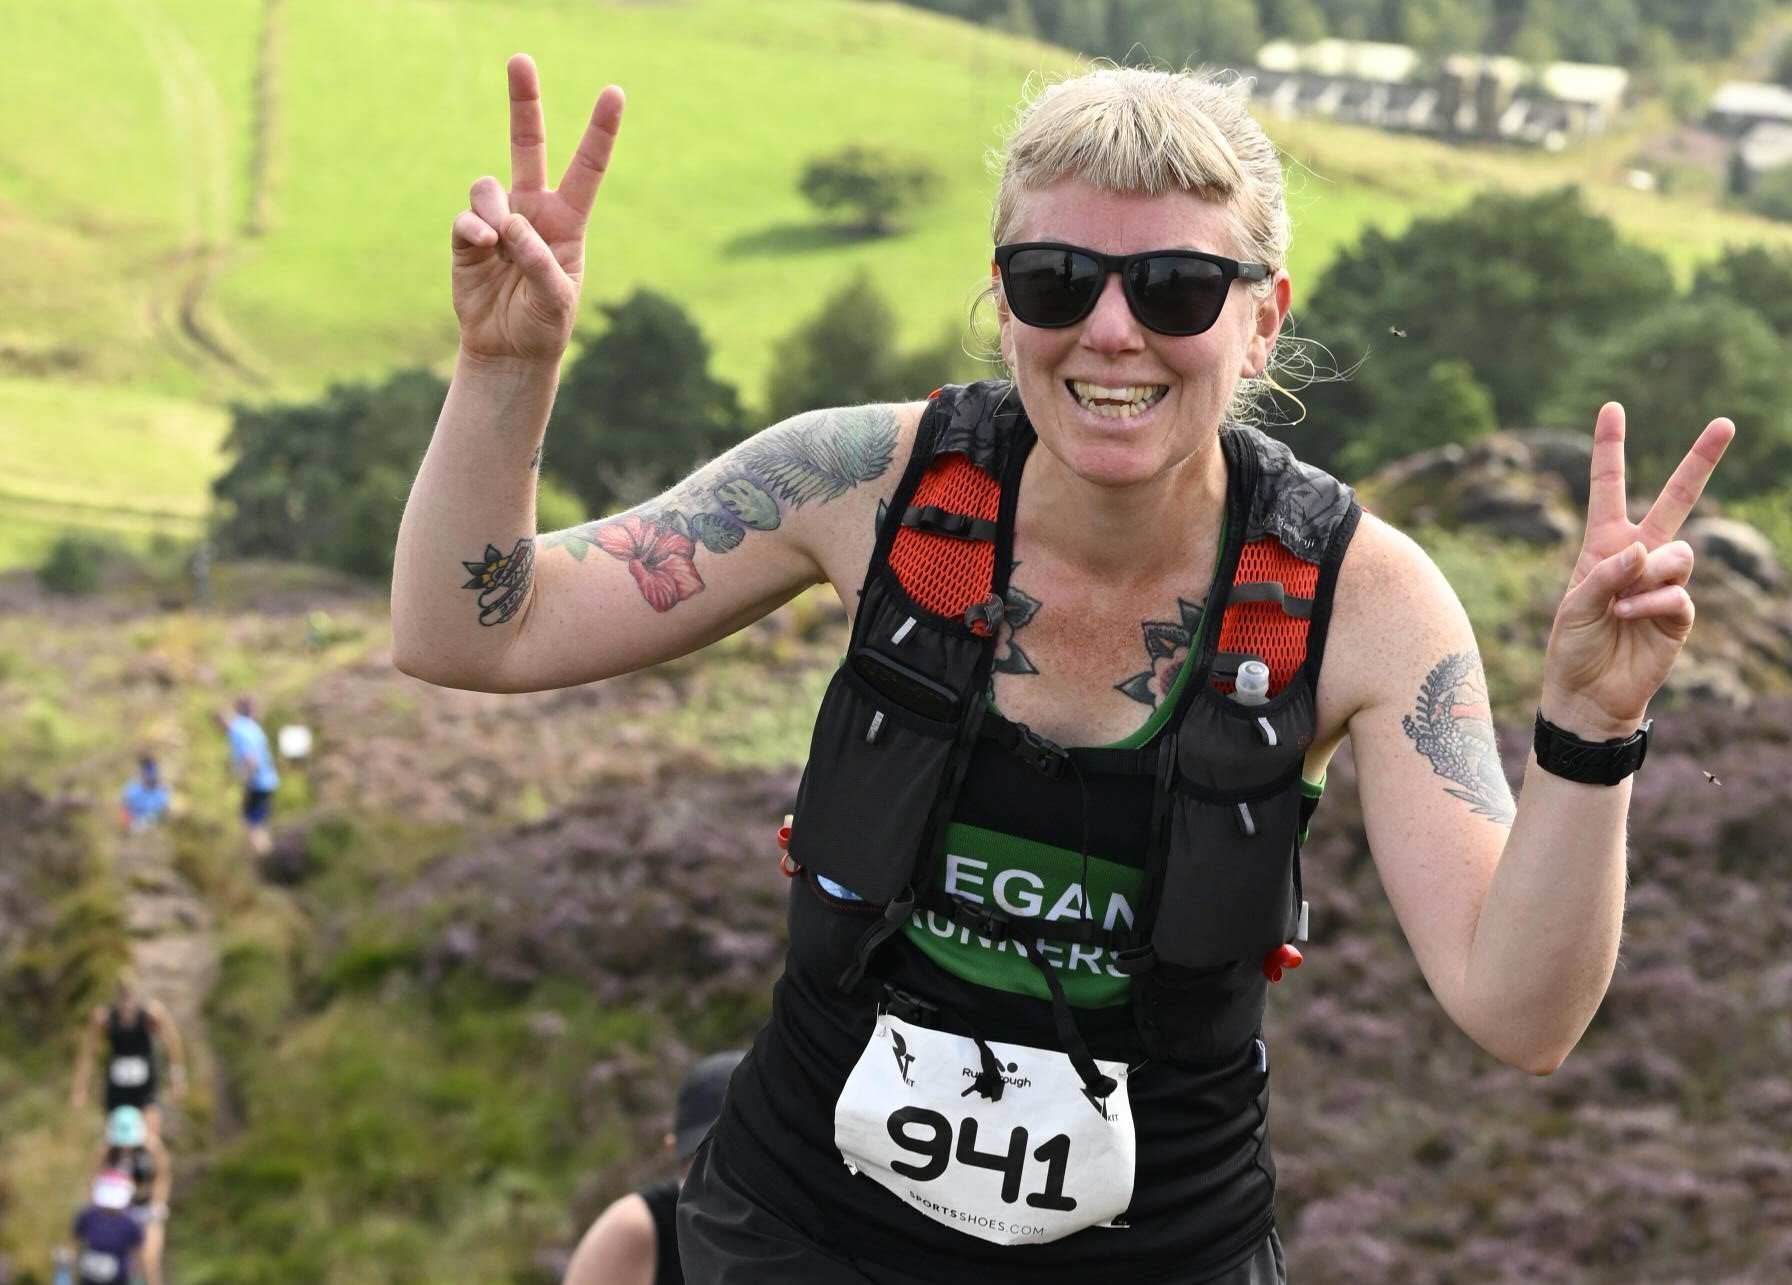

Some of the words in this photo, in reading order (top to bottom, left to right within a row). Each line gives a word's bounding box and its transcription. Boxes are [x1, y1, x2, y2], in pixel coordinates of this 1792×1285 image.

[945, 854, 1135, 932] EGAN
[962, 1067, 1032, 1089] Ruough
[886, 1105, 1078, 1212] 941
